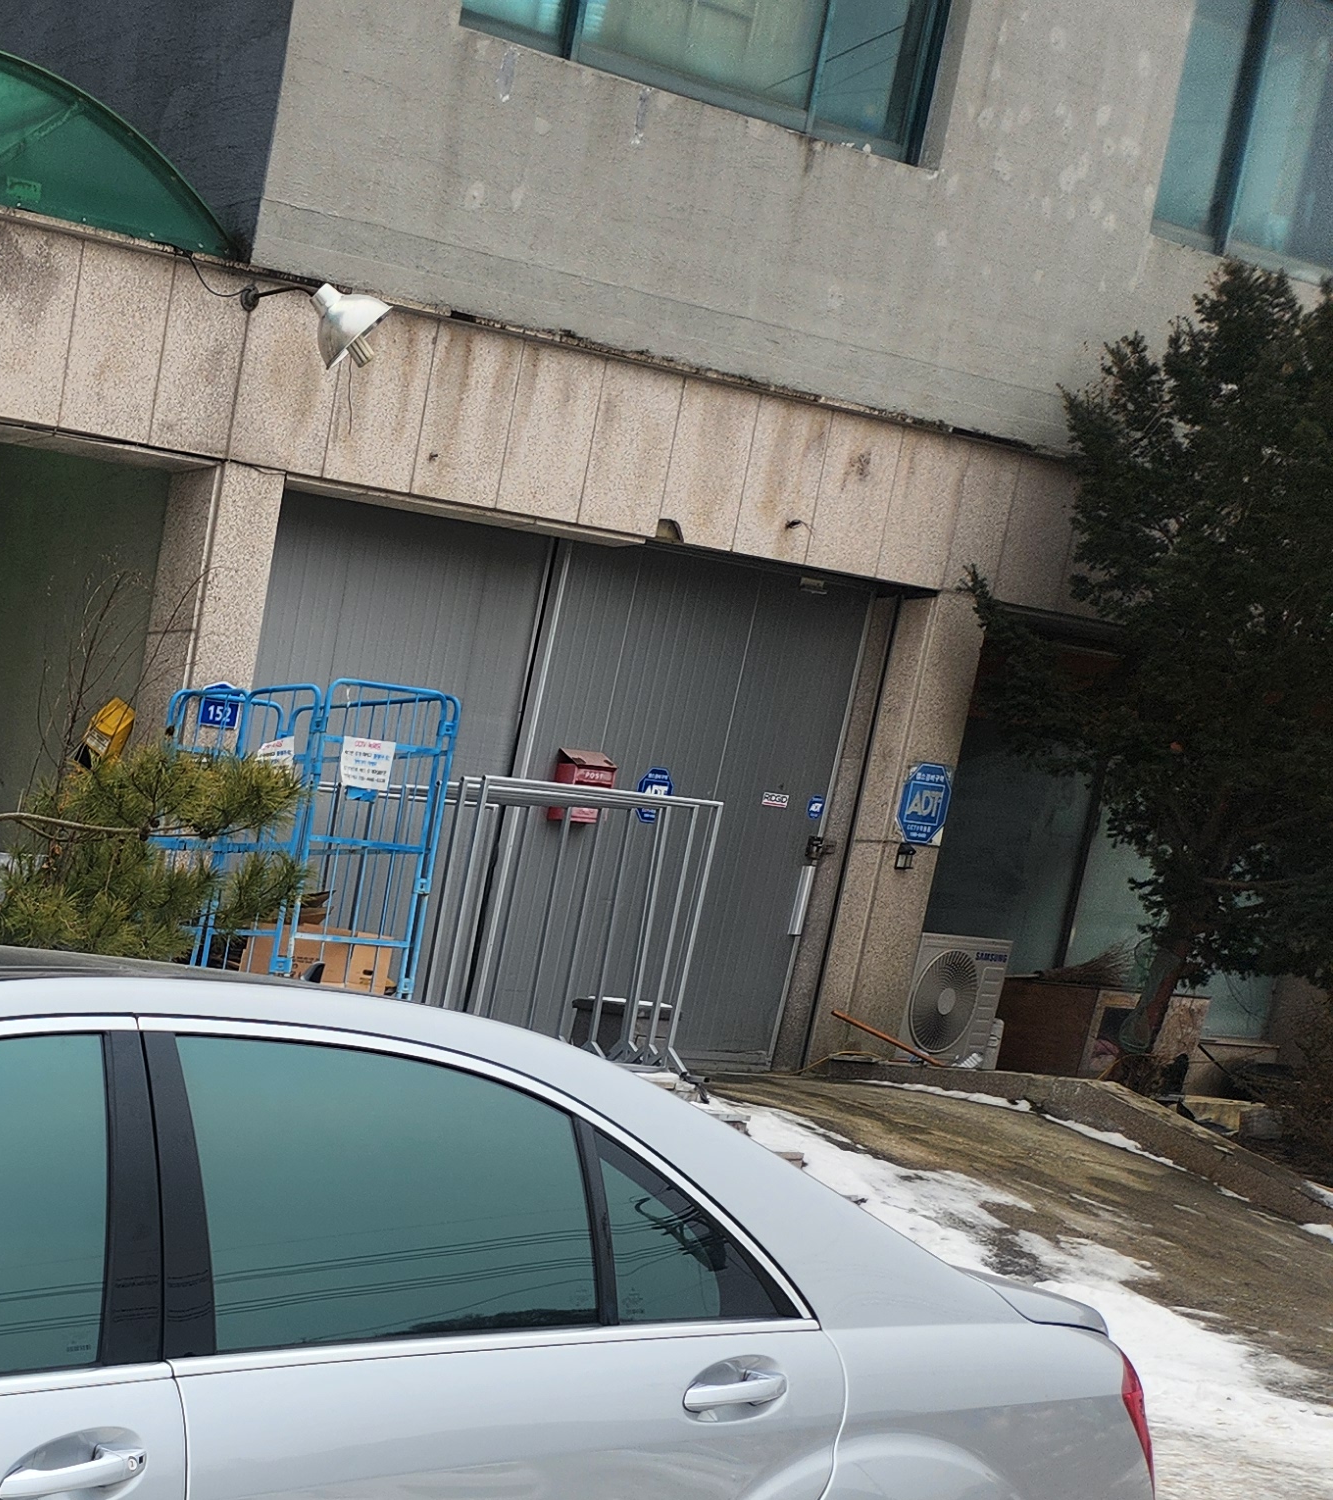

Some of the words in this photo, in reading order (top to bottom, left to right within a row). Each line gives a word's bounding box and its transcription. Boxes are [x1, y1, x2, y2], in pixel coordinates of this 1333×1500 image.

[208, 705, 232, 722] 152
[585, 771, 604, 780] POST
[906, 790, 942, 817] ADT
[975, 952, 1007, 963] SAMSUNG
